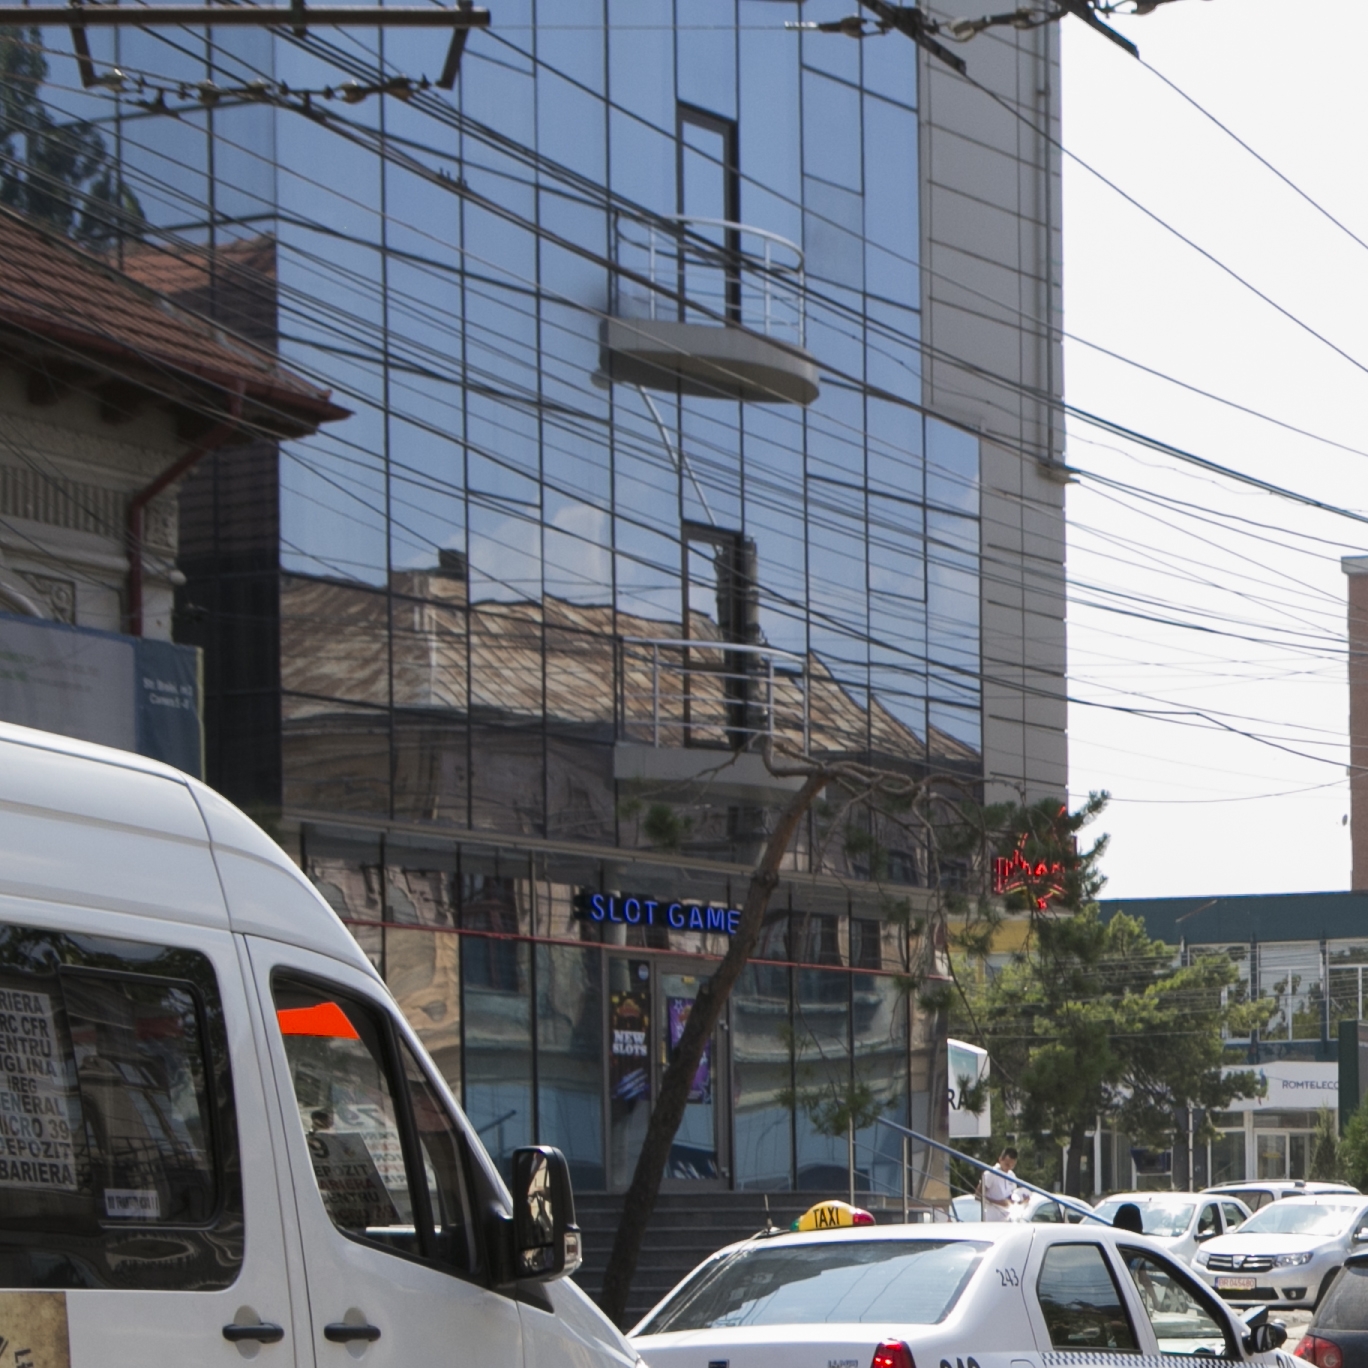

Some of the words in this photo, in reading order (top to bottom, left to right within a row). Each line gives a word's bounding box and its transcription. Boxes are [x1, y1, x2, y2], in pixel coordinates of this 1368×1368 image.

[591, 894, 658, 925] SLOT
[668, 903, 742, 934] GAME
[21, 1015, 49, 1038] CFR
[613, 1030, 645, 1044] NEW
[612, 1043, 647, 1056] SLOTS
[49, 1118, 70, 1140] 39
[0, 1159, 73, 1185] BARIERA
[316, 1164, 368, 1178] EPOZIT
[320, 1178, 376, 1191] ARIERA
[813, 1207, 840, 1228] TAXI
